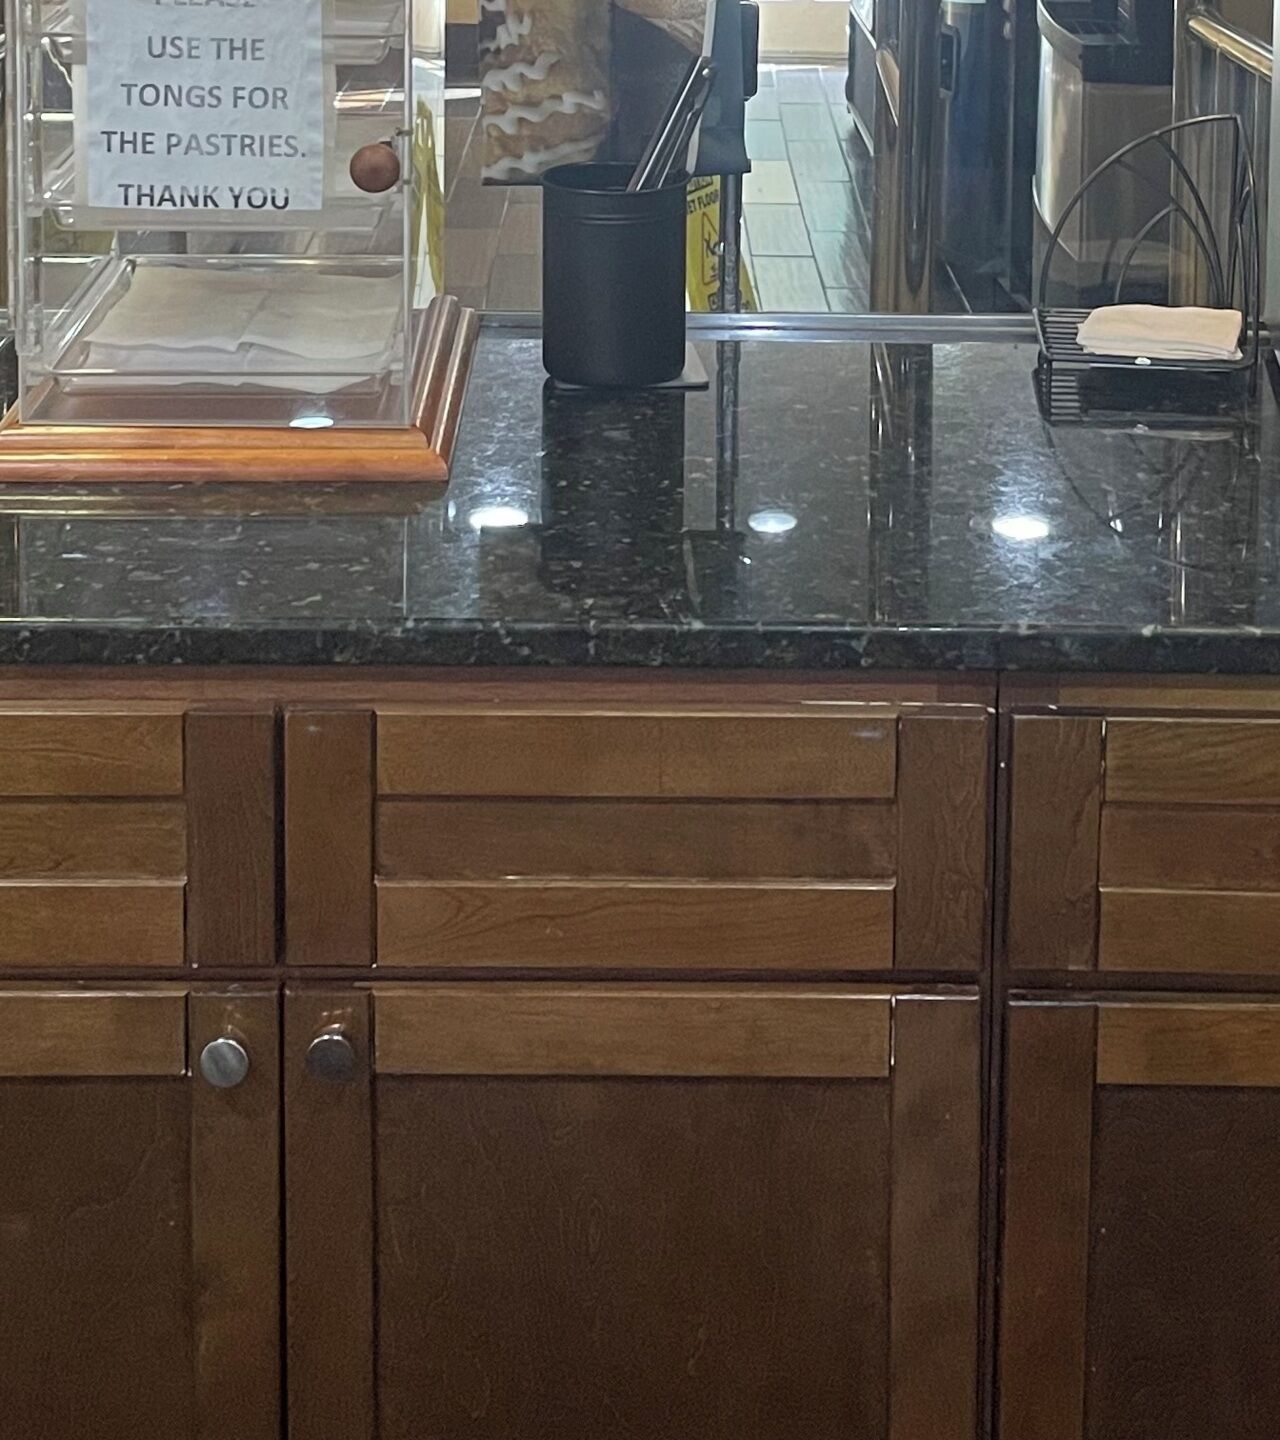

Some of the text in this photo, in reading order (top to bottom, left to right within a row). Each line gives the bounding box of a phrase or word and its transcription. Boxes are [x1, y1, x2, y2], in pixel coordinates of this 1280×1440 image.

[147, 36, 265, 61] USE THE
[120, 83, 288, 110] TONGS FOR
[101, 130, 306, 158] THE PASTRIES.
[118, 184, 290, 210] THANK YOU
